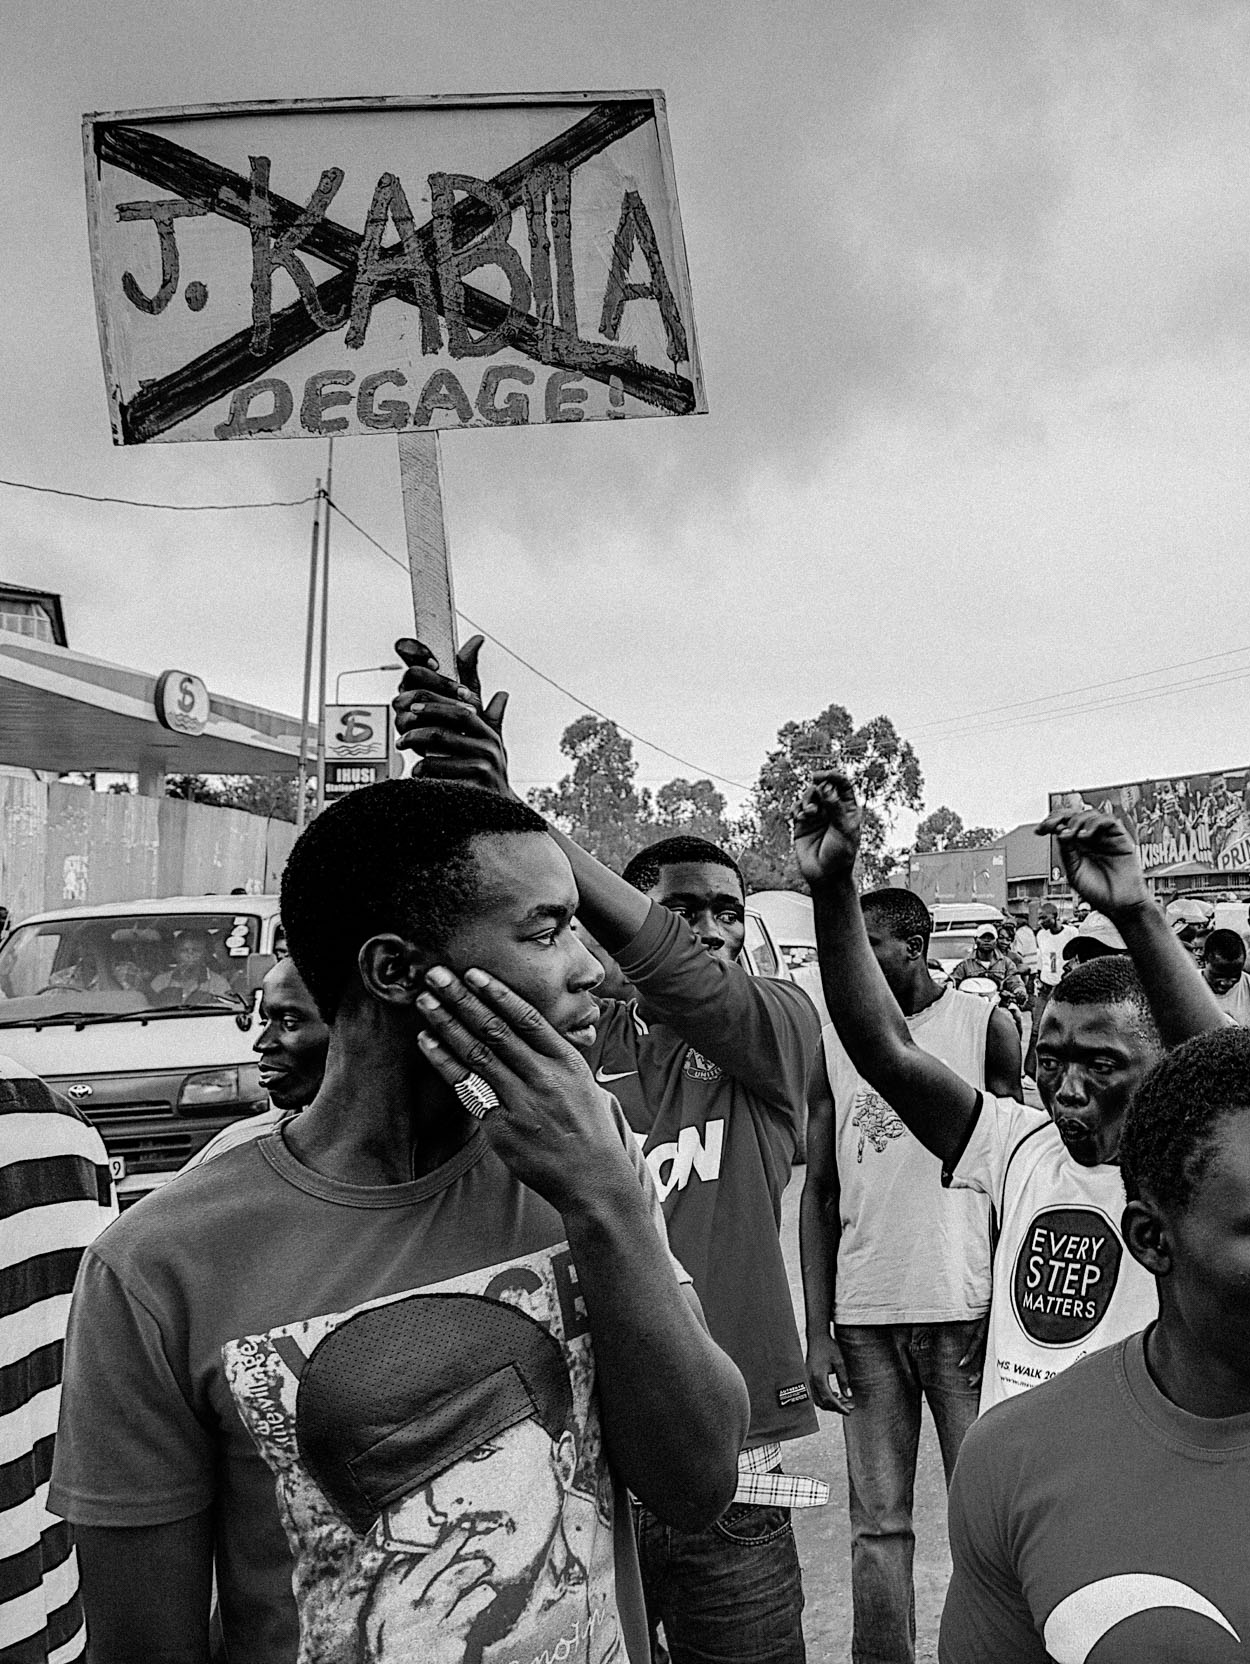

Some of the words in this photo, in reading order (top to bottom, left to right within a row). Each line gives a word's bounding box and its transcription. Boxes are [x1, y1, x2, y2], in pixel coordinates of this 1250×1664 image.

[115, 199, 212, 314] J.
[248, 156, 688, 366] KABILA
[336, 768, 376, 783] IHUSI
[632, 1119, 724, 1202] ON
[1031, 1228, 1105, 1261] EVERY
[1026, 1256, 1101, 1297] STEP
[1023, 1291, 1096, 1319] MATTERS
[1013, 1364, 1042, 1380] WALK
